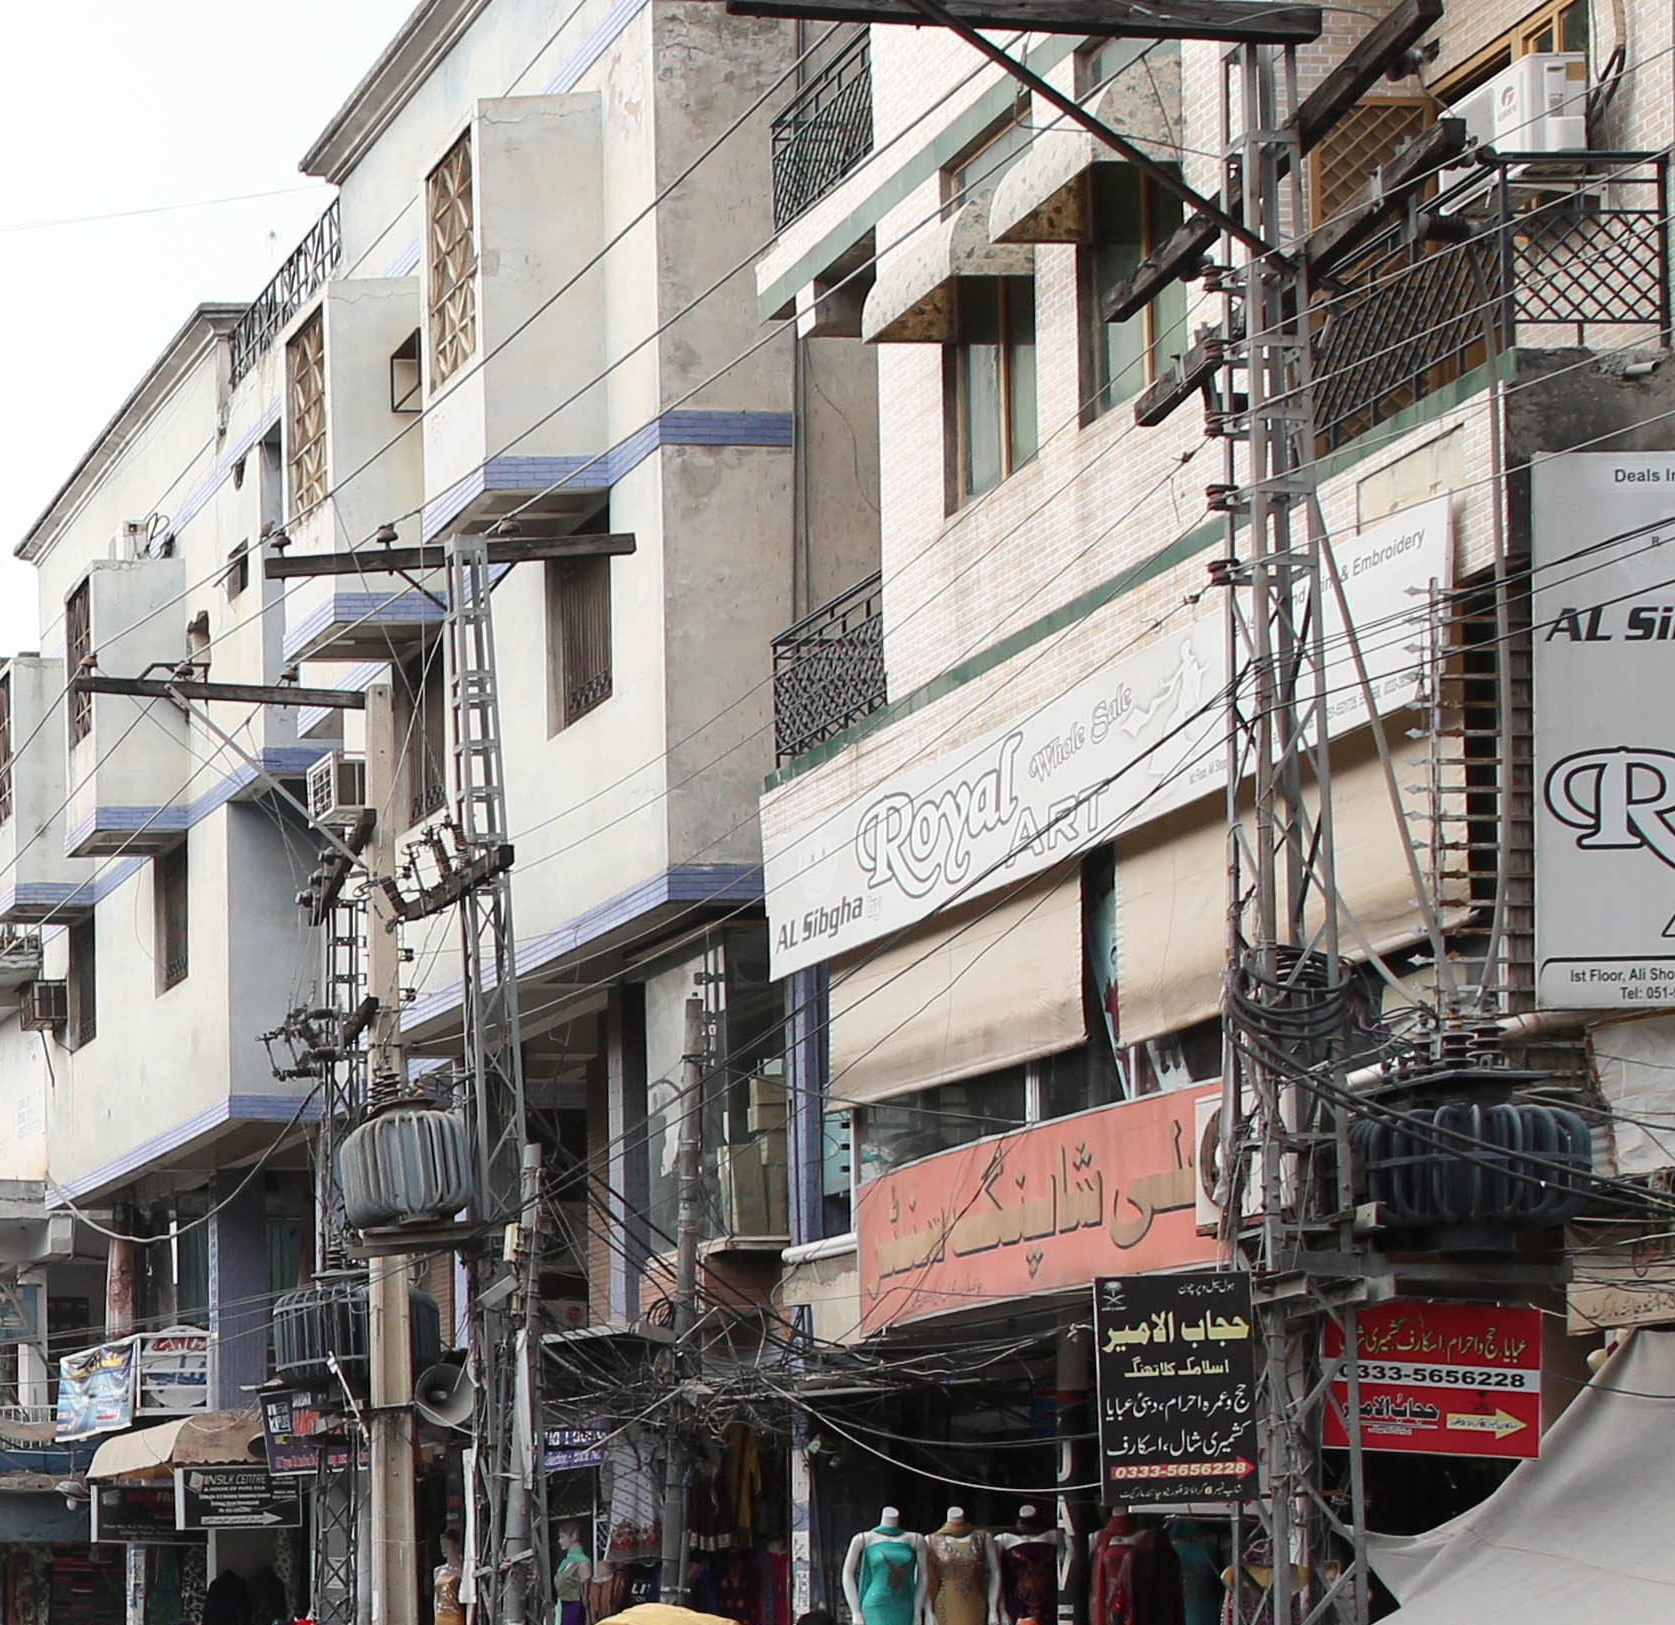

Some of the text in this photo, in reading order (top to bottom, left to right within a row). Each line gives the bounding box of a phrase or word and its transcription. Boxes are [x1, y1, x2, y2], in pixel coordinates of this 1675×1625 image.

[1614, 468, 1660, 483] Deals
[1352, 527, 1426, 576] Embroidery
[1544, 606, 1675, 642] AL Si
[1028, 683, 1132, 782] Whole Sale
[855, 731, 1024, 899] Royal
[1005, 778, 1111, 868] ART
[775, 921, 799, 953] AL
[802, 896, 863, 940] Sibgha
[1589, 968, 1625, 986] Floor,
[1630, 968, 1645, 984] Ali
[1648, 968, 1675, 984] Sho
[1620, 986, 1643, 1001] Tel:
[1101, 1309, 1251, 1353] حجاب الامیر
[1113, 1461, 1248, 1480] 0333-5656228
